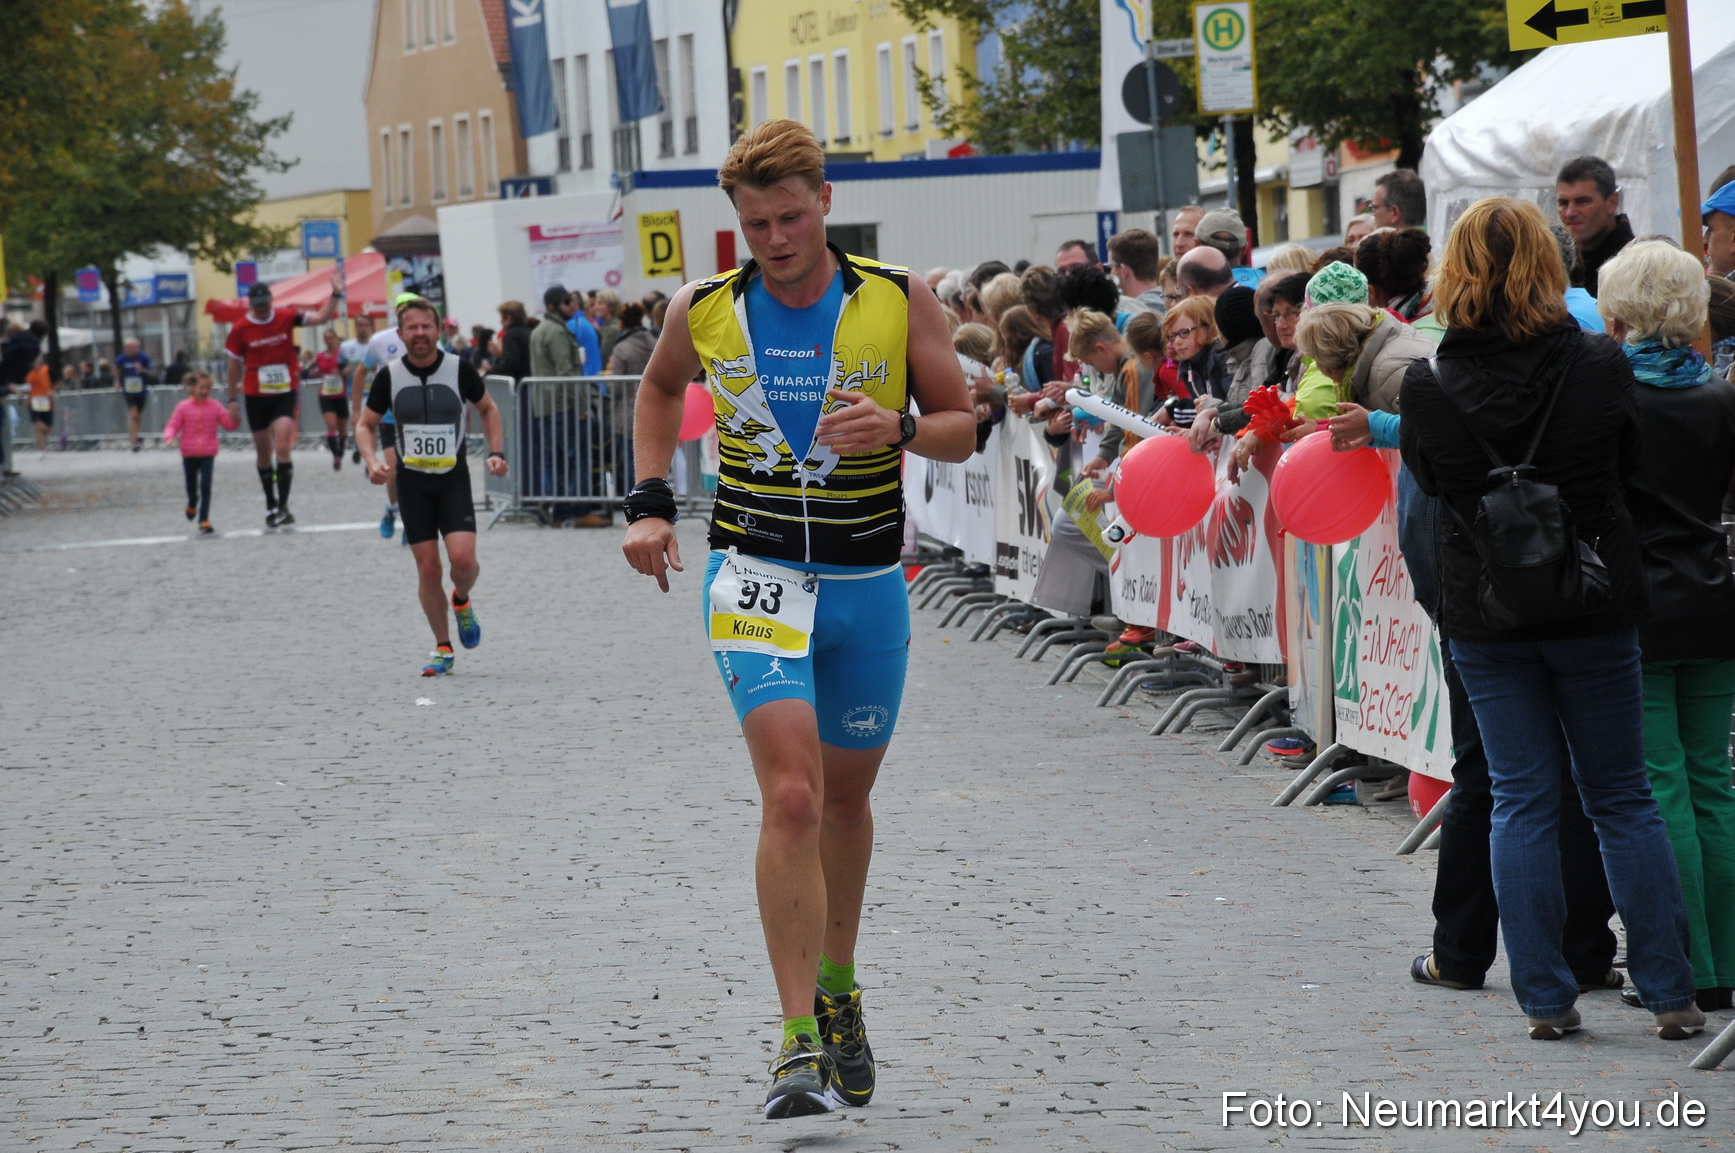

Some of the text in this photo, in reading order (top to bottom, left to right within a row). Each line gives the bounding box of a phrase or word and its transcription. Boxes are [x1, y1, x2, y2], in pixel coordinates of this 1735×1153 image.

[789, 10, 820, 47] HOTEL
[642, 215, 677, 228] Block
[650, 231, 673, 263] D
[765, 347, 815, 358] cocoon
[413, 437, 446, 456] 360
[737, 579, 783, 615] 93
[733, 619, 773, 639] Klaus
[1359, 680, 1413, 741] BESSER
